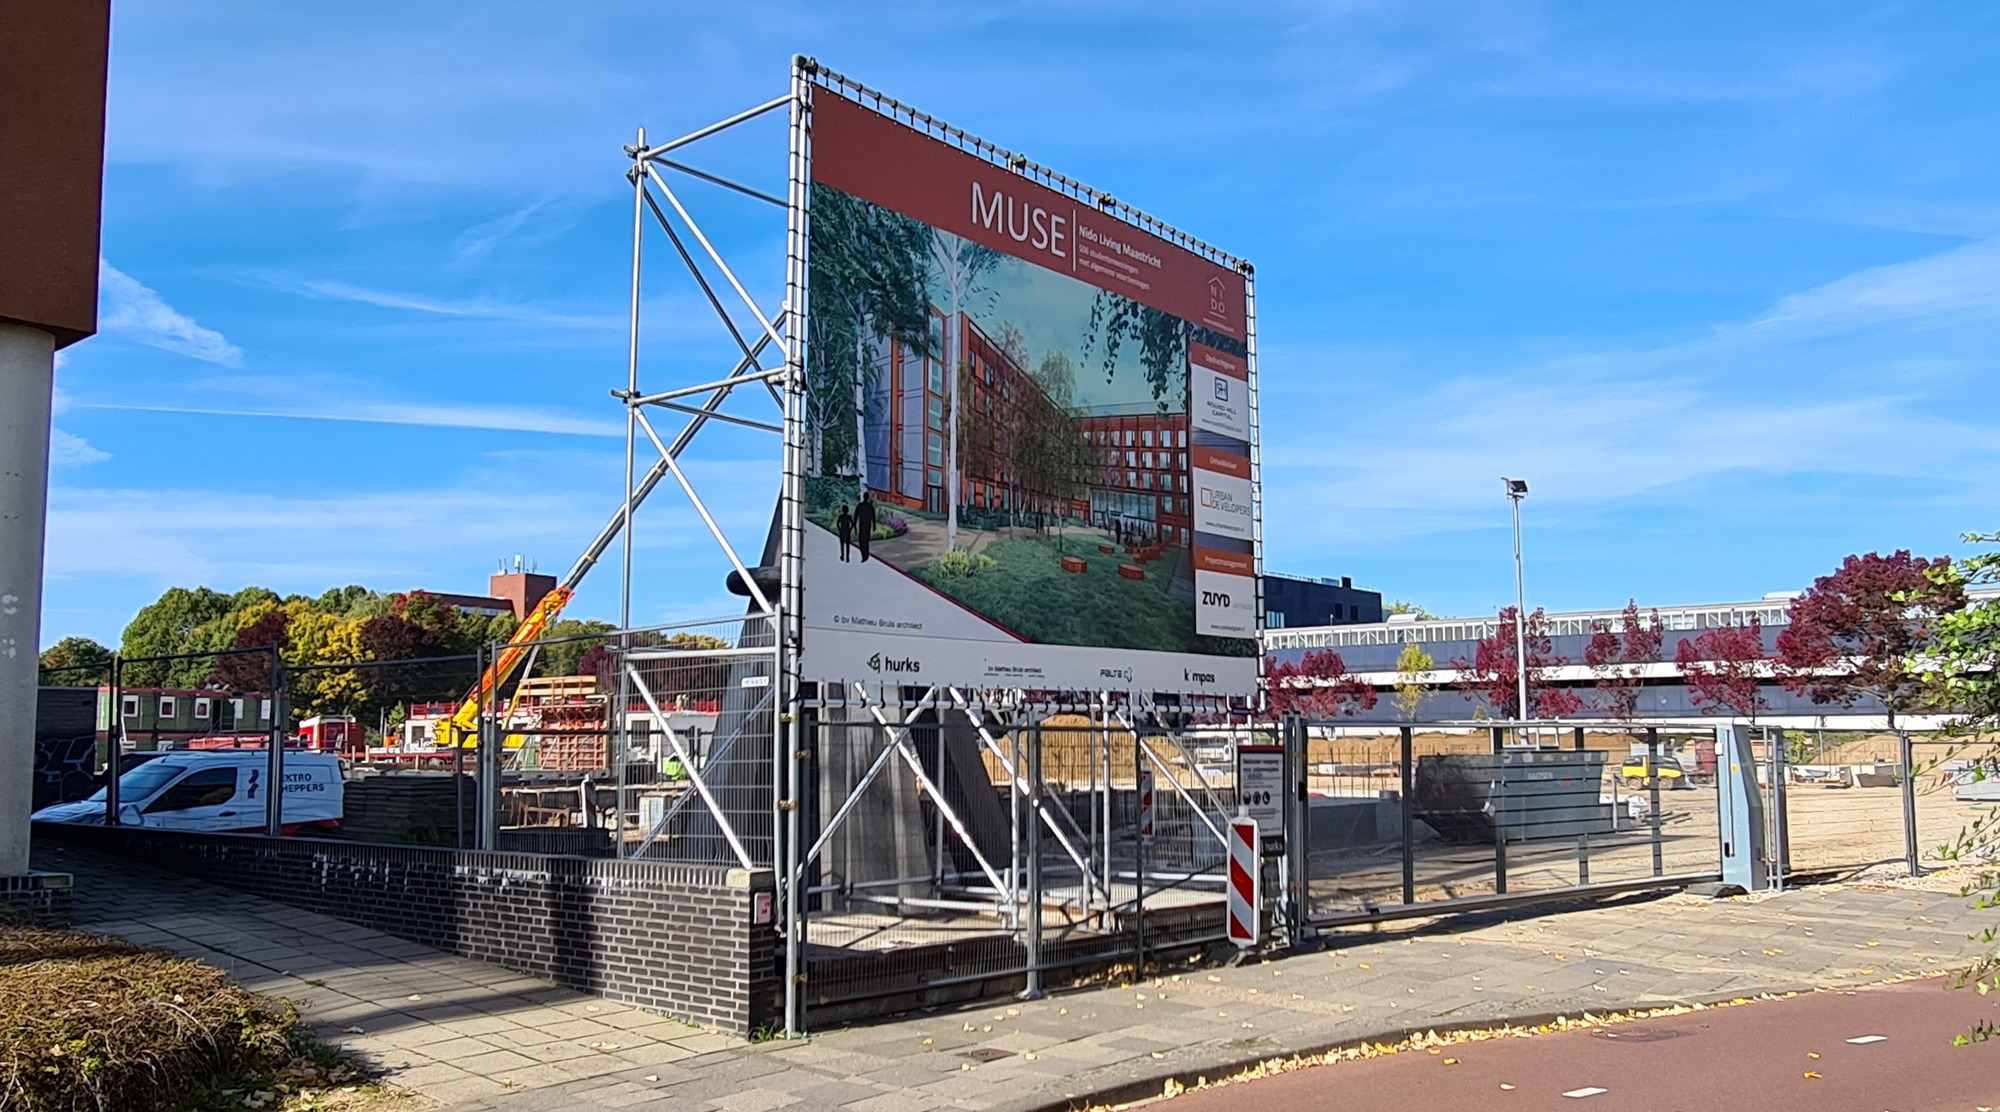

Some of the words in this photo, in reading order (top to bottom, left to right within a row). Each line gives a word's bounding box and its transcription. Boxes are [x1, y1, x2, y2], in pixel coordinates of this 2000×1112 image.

[972, 181, 1066, 258] MUSE
[1079, 224, 1098, 242] Nido
[1100, 234, 1121, 254] Living
[1123, 243, 1162, 269] Maastricht
[1212, 489, 1233, 502] URBAN
[1212, 500, 1250, 517] DEVELOPERS
[1202, 590, 1231, 608] ZUYD
[885, 656, 921, 673] hurks
[1184, 668, 1215, 686] kmpas
[281, 783, 325, 793] HEPPERS
